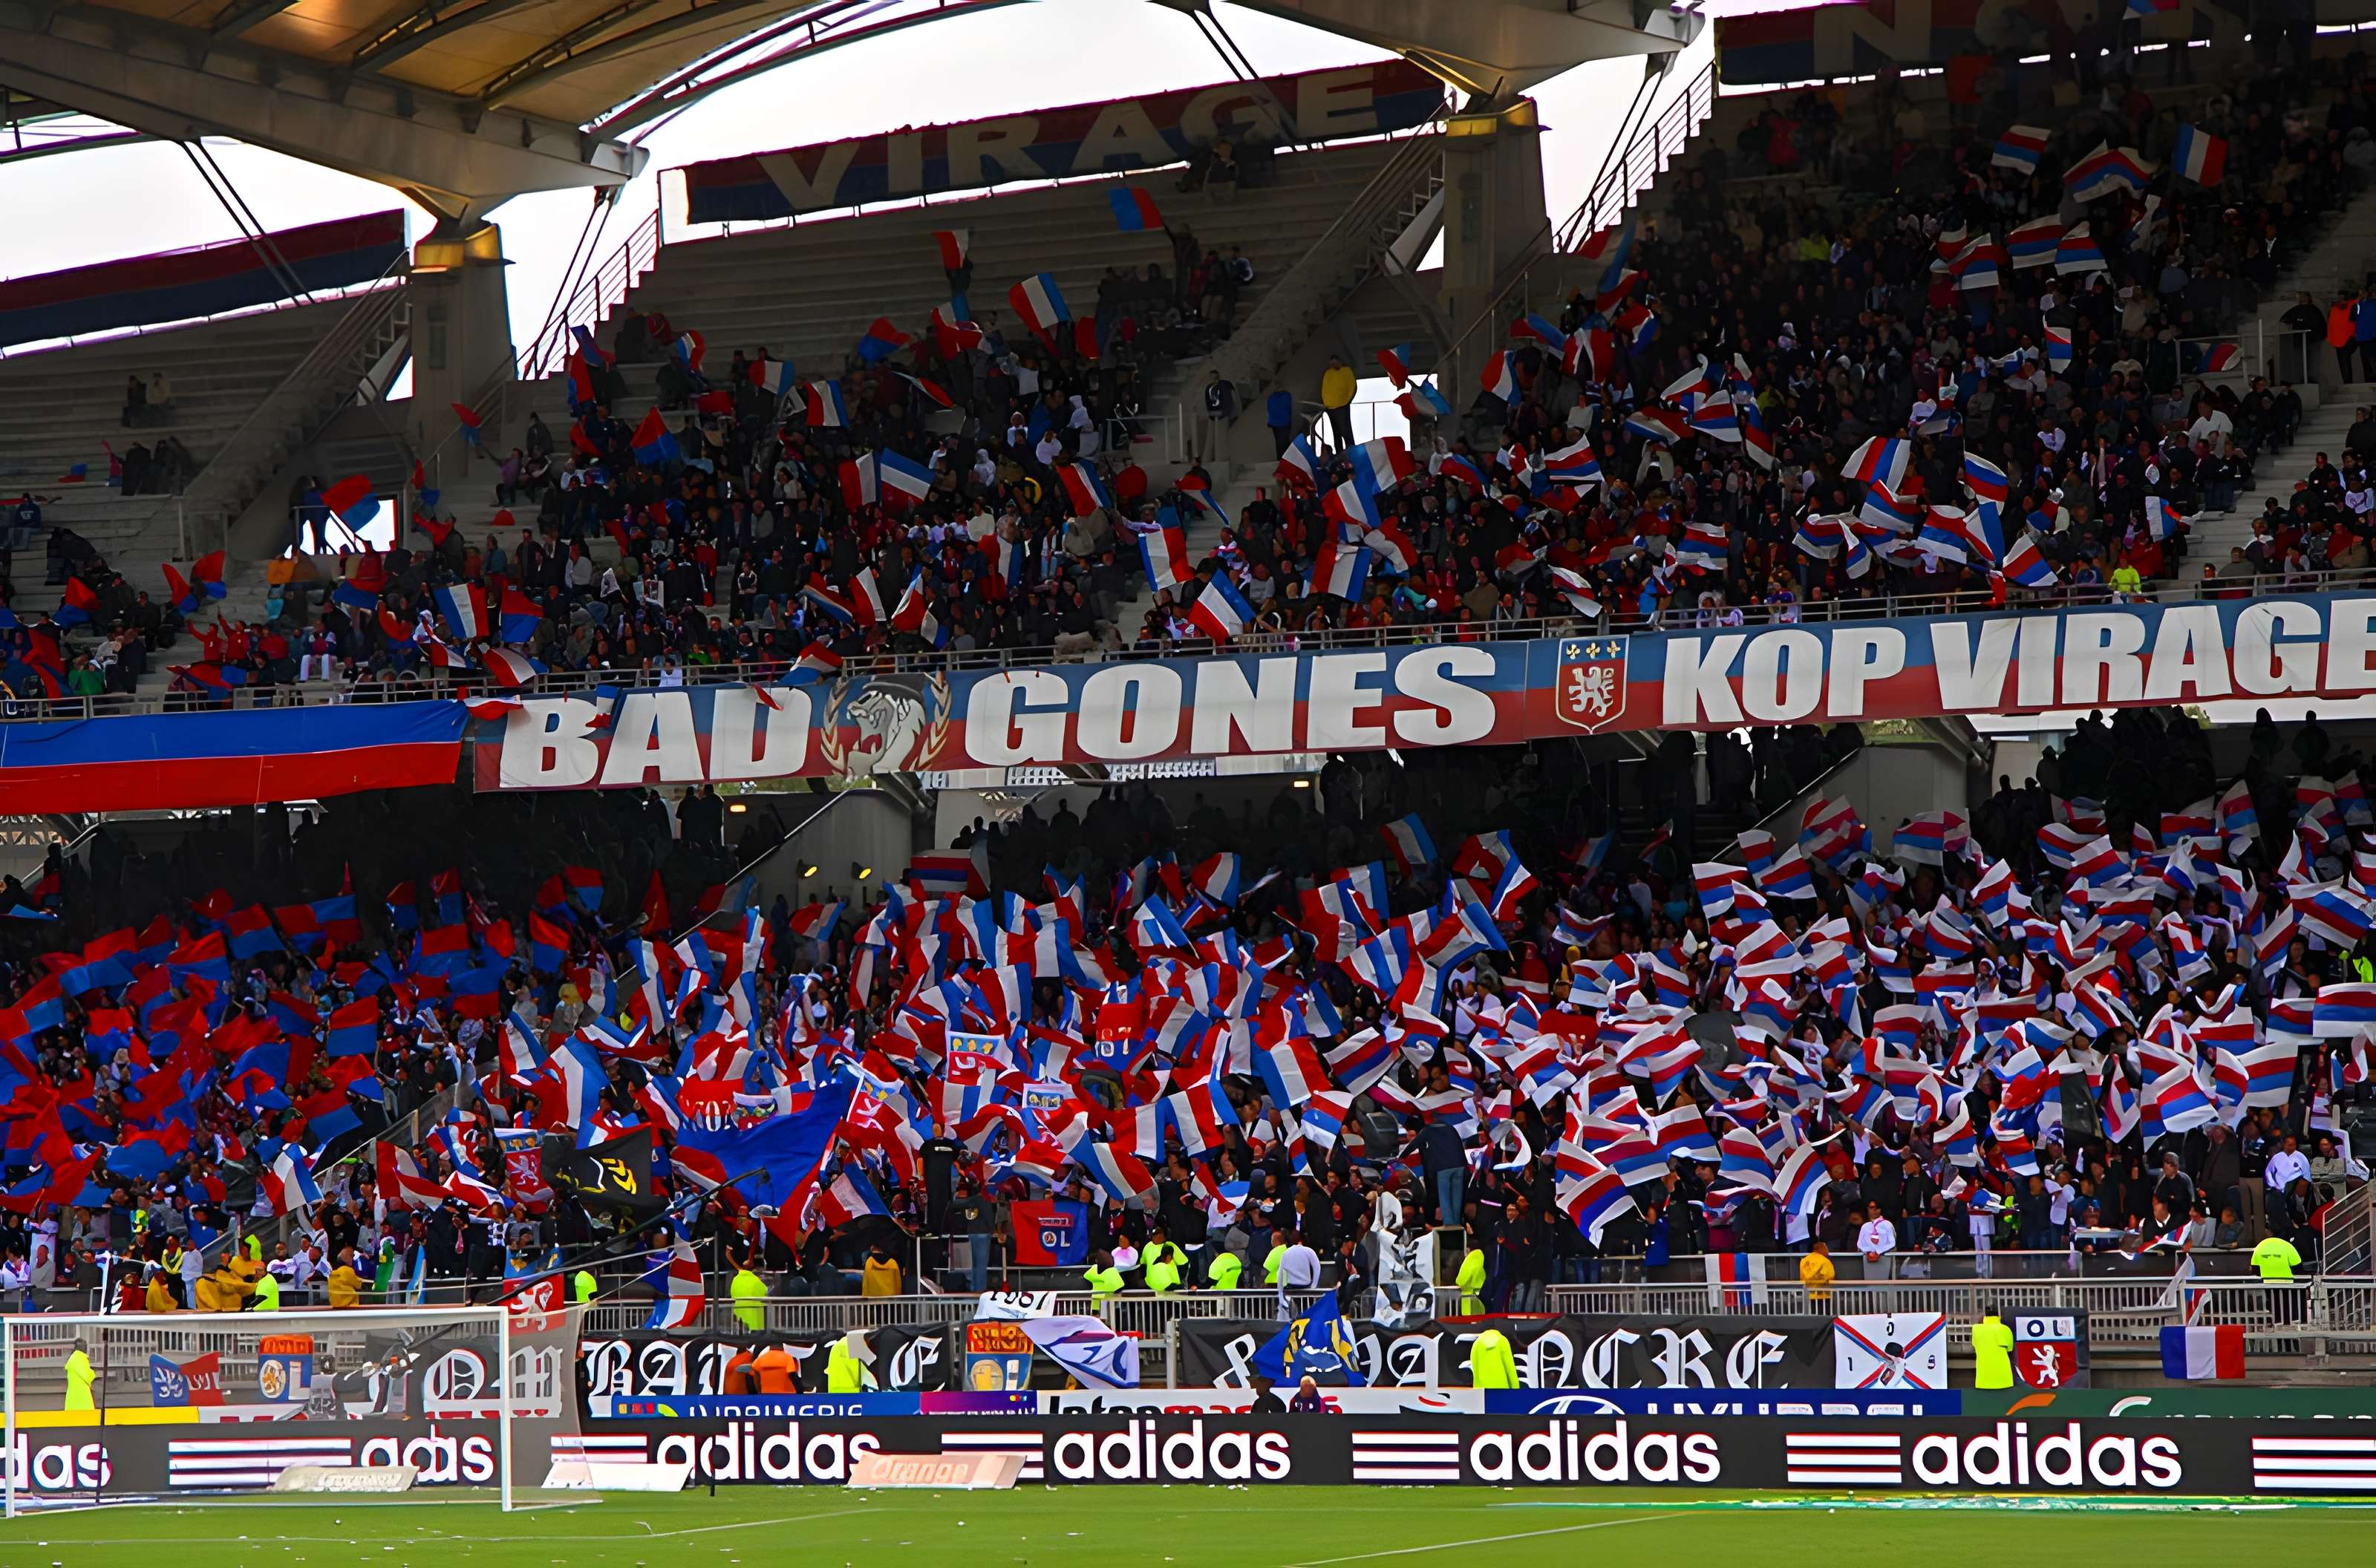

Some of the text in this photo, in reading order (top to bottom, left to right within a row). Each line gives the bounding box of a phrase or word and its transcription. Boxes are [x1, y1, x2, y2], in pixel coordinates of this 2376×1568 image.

[756, 66, 1378, 210] VIRAGE
[500, 687, 812, 787] BAD
[965, 646, 1496, 766] GONES
[1662, 627, 1907, 725] KOP
[656, 1421, 881, 1480] adidas
[1053, 1419, 1292, 1480] adidas
[1470, 1420, 1721, 1481] adidas
[1911, 1421, 2183, 1486] adidas
